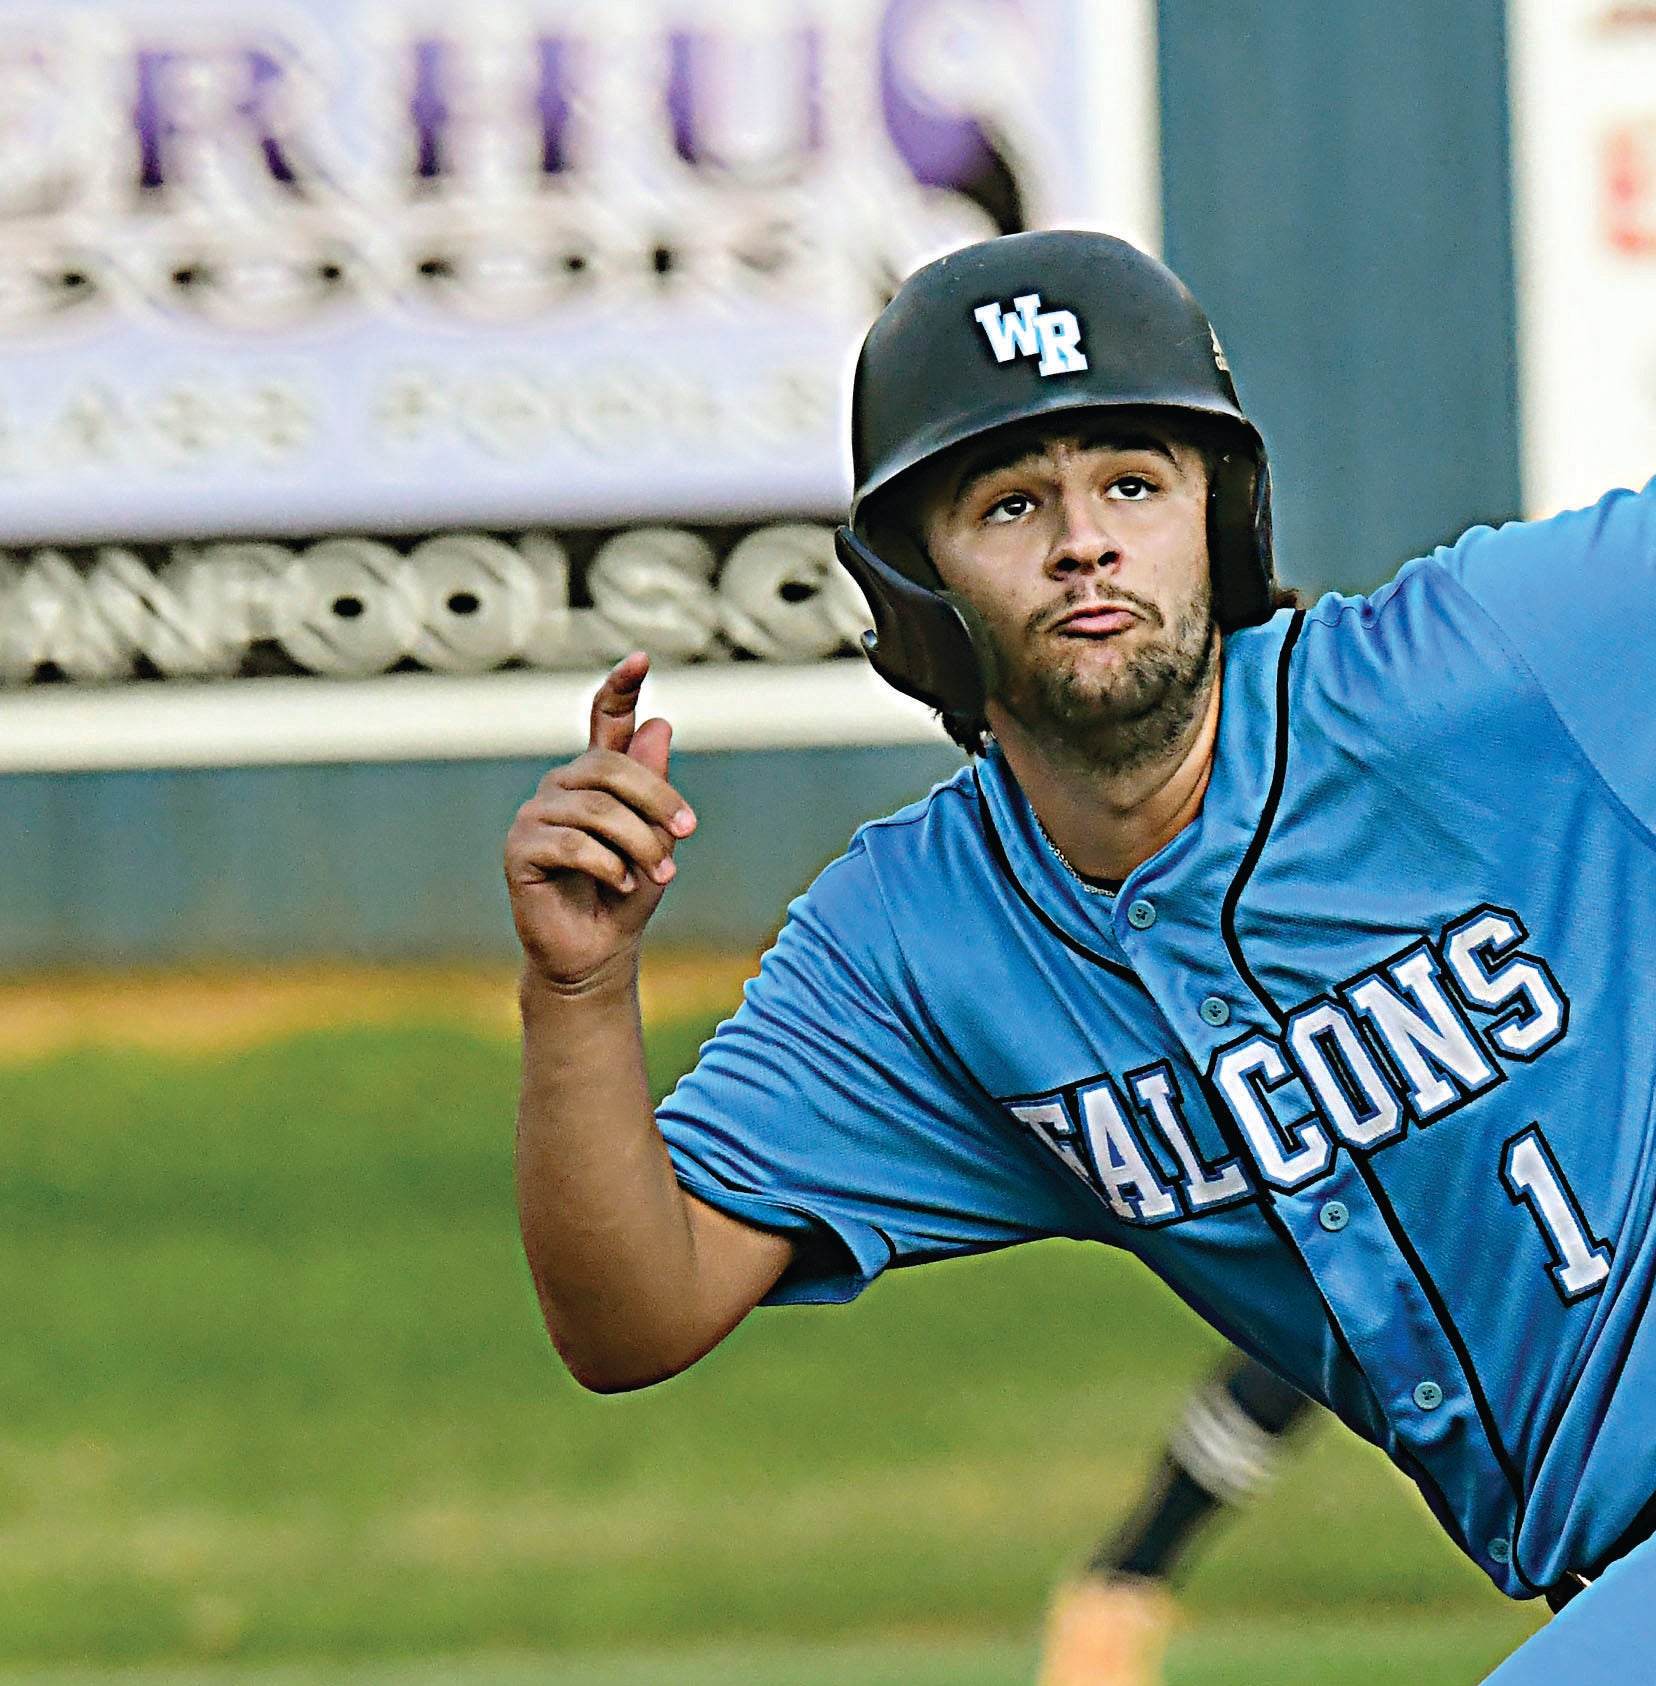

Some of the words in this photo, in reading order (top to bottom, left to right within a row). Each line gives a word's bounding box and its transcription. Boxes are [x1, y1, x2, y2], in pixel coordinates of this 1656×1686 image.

[974, 294, 1088, 376] WR
[1003, 903, 1569, 1228] FALCONS
[1501, 1121, 1614, 1307] 1
